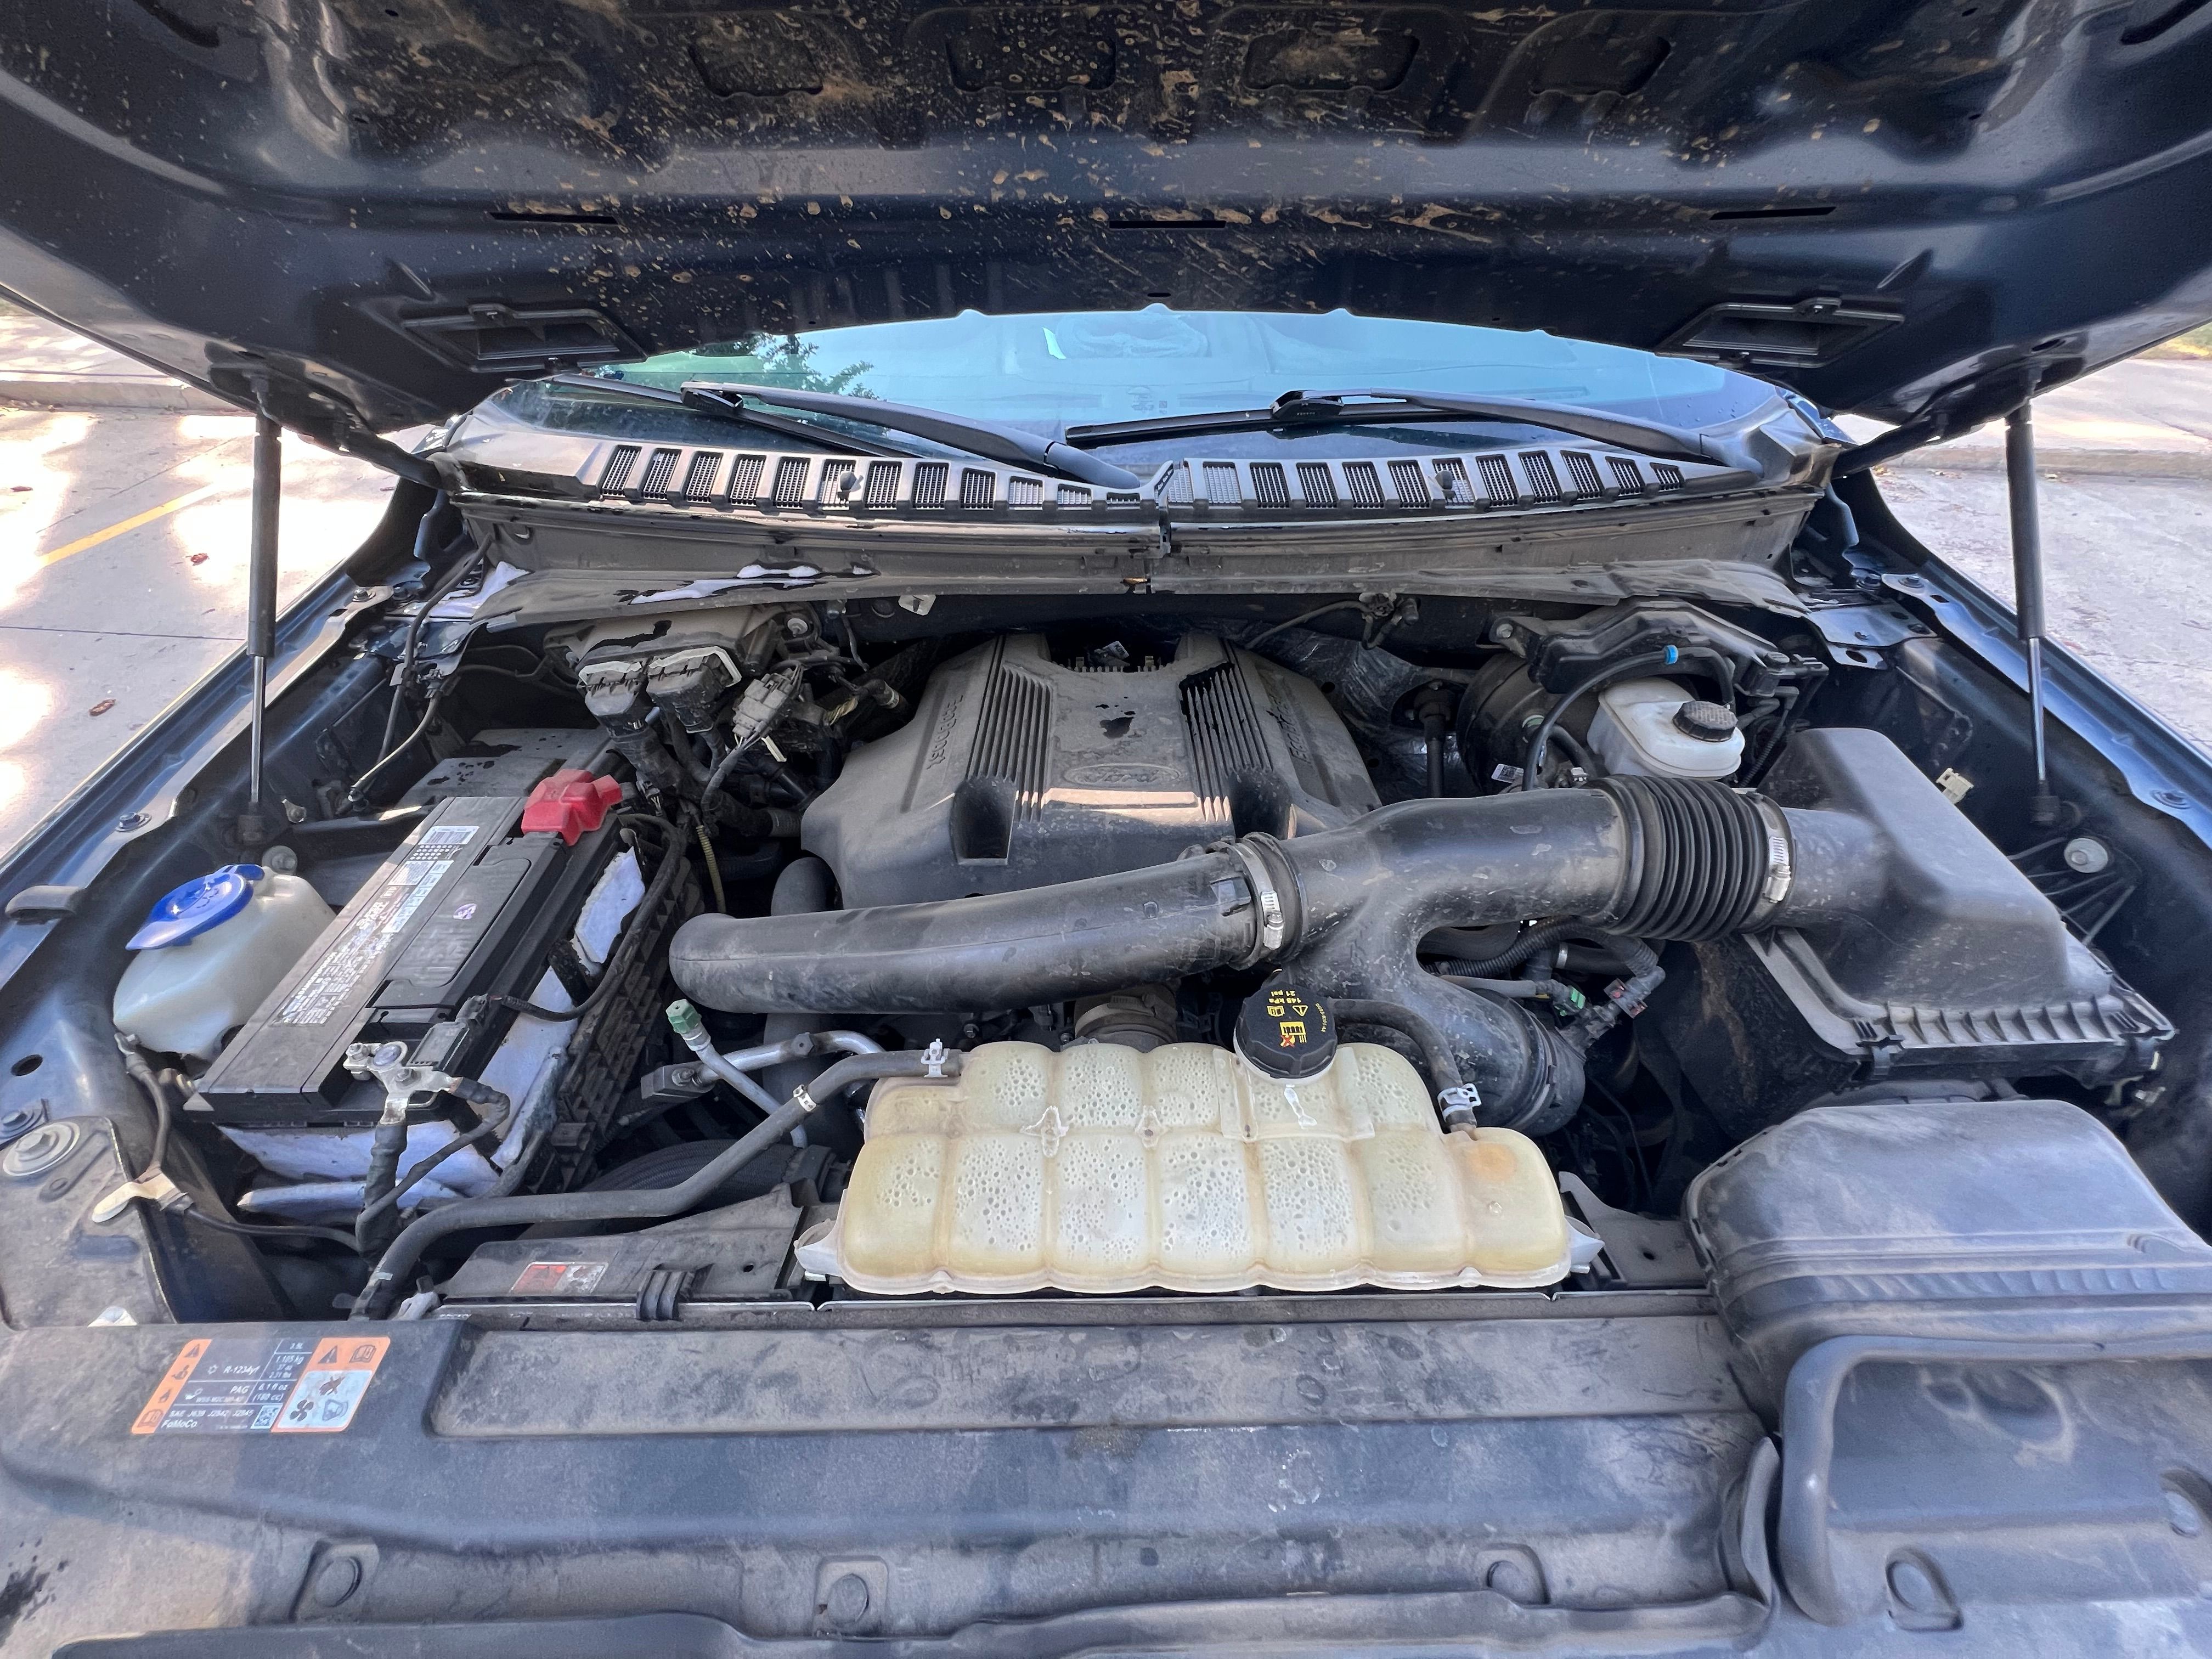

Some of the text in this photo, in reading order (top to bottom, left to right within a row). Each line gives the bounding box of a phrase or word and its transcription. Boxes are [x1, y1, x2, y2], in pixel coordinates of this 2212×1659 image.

[223, 1365, 261, 1375] R-1234yf
[271, 1393, 284, 1402] cc)
[161, 1419, 198, 1429] FoMoCo
